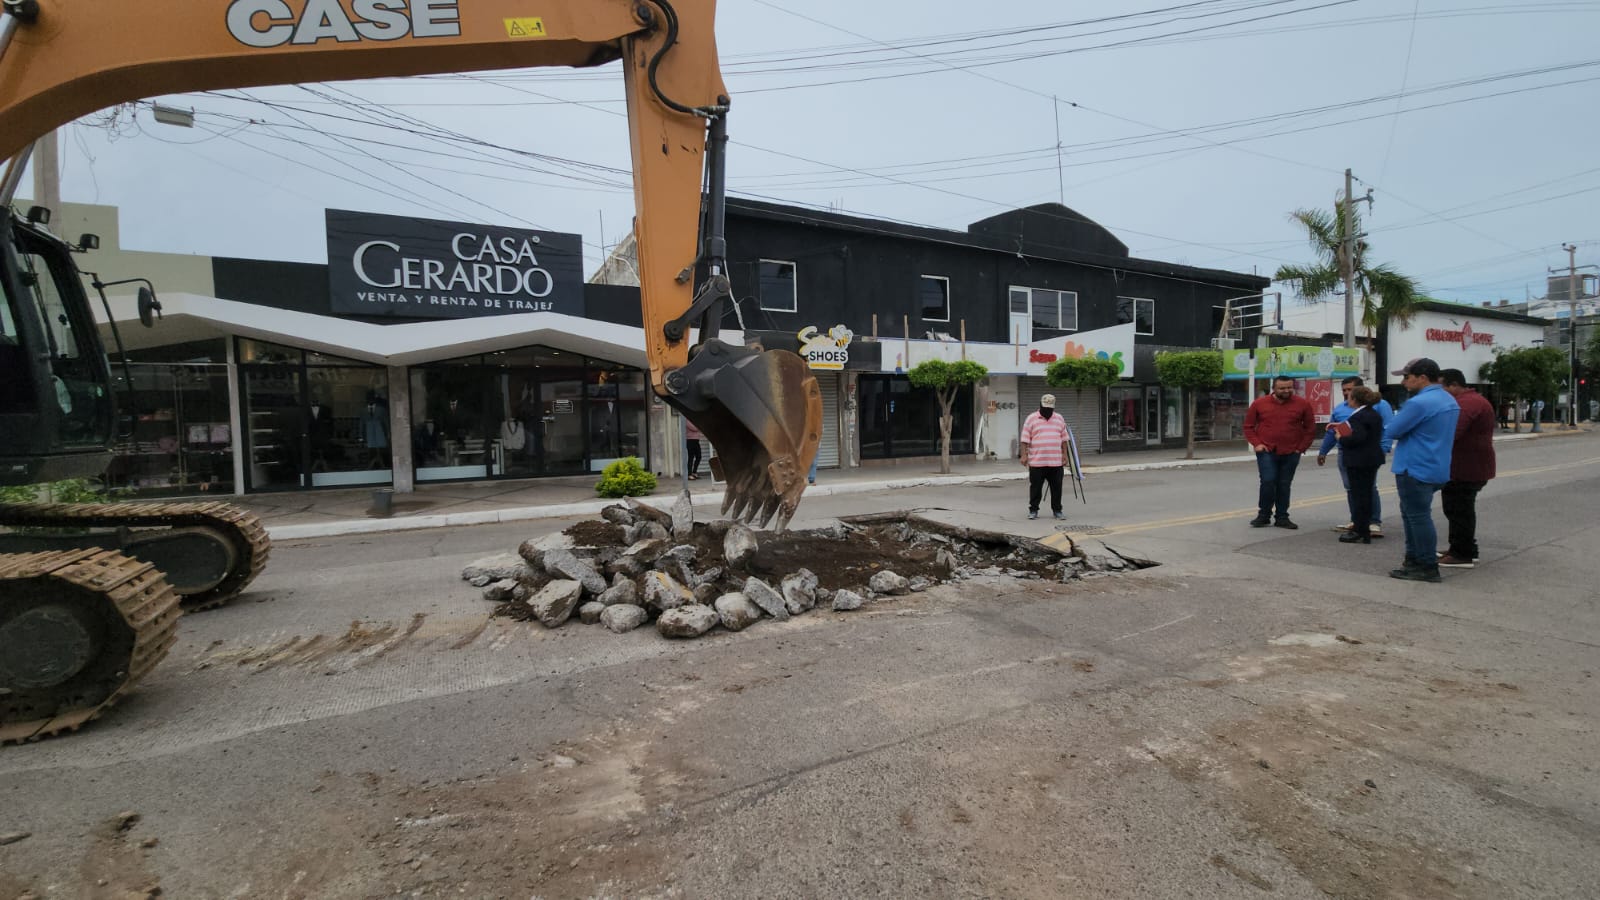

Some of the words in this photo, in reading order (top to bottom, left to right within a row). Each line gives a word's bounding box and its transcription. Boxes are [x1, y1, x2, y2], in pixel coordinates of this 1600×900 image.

[226, 0, 461, 47] CASE
[452, 233, 539, 266] CASA
[353, 240, 553, 297] GERARDO
[357, 292, 407, 303] VENTA
[414, 295, 423, 304] Y
[430, 295, 477, 306] RENTA
[484, 299, 501, 308] DE
[508, 300, 553, 311] TRAJES
[809, 351, 847, 361] SHOES
